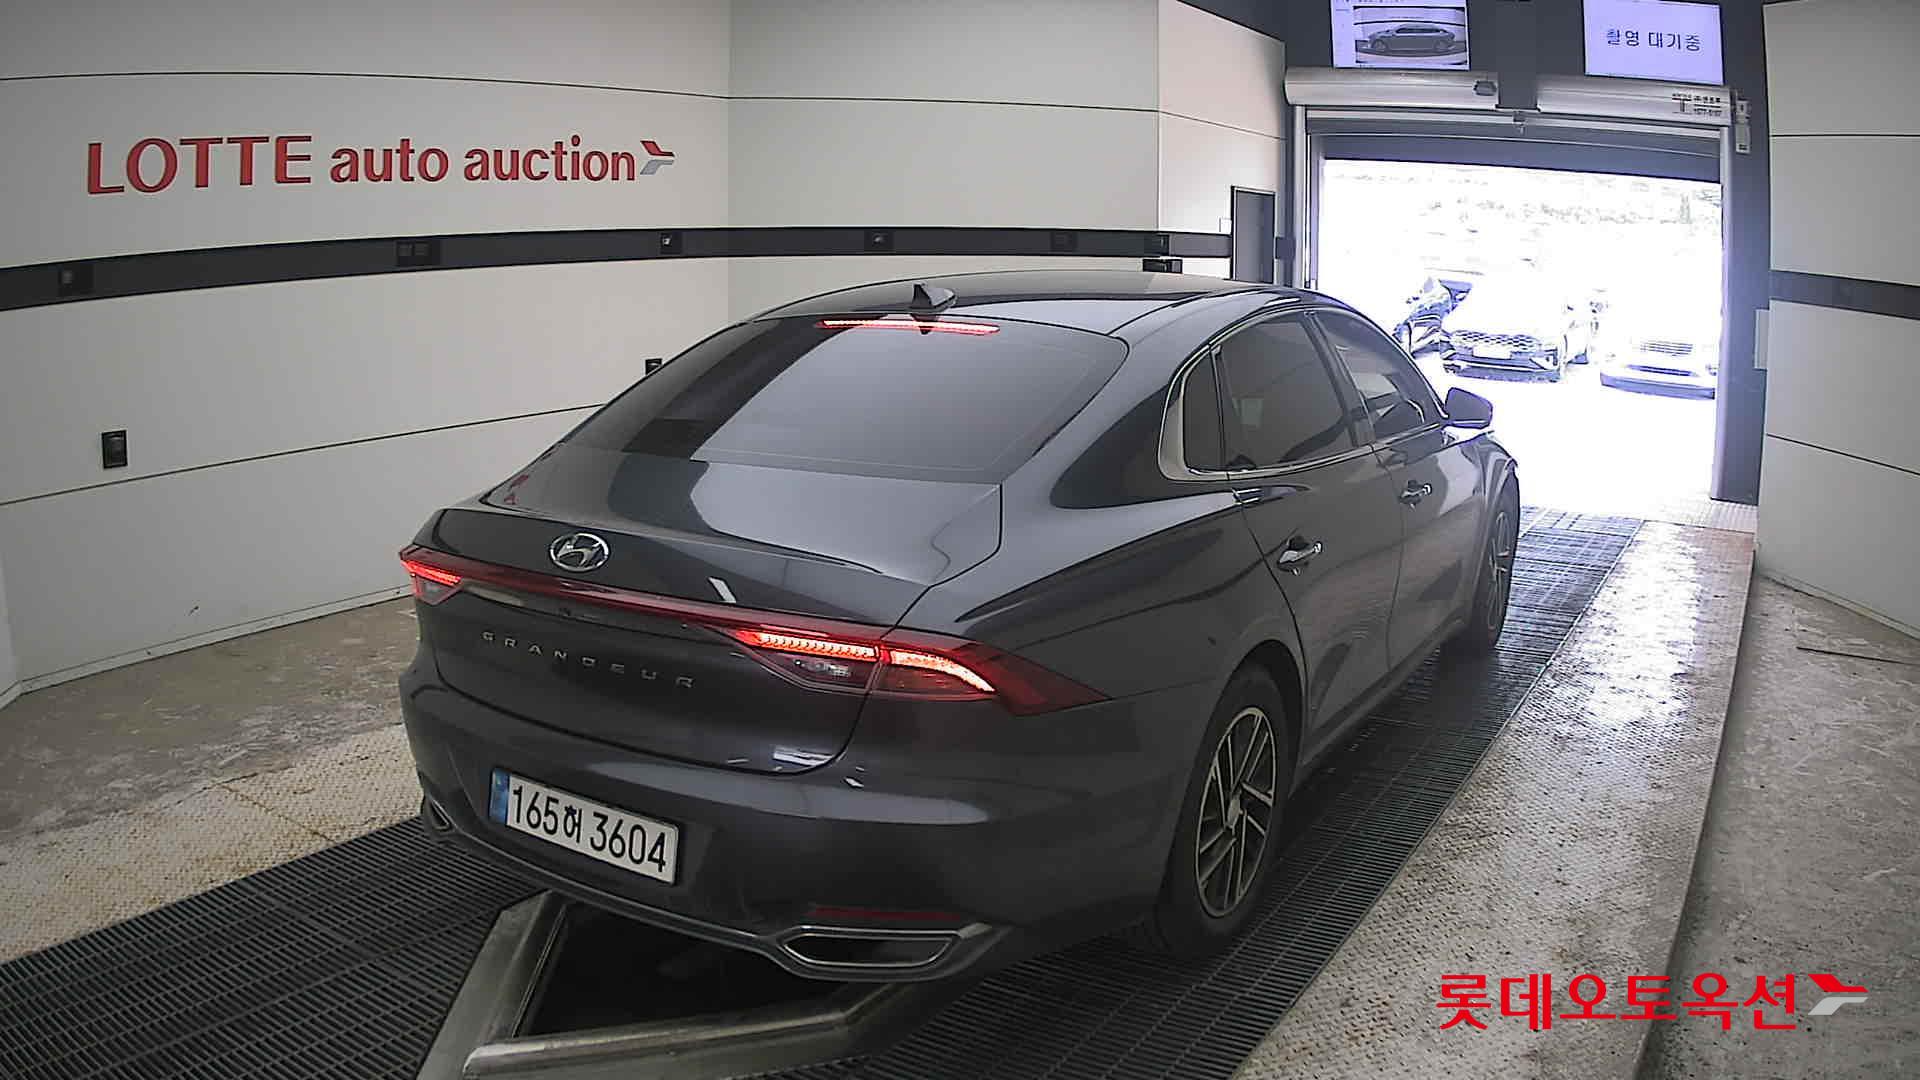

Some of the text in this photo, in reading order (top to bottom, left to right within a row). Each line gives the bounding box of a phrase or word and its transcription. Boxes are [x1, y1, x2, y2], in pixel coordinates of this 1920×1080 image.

[1648, 31, 1701, 52] 대기중
[87, 134, 637, 195] LOTTE auto auction
[481, 630, 694, 688] GRANDEUR
[589, 811, 667, 873] 3604
